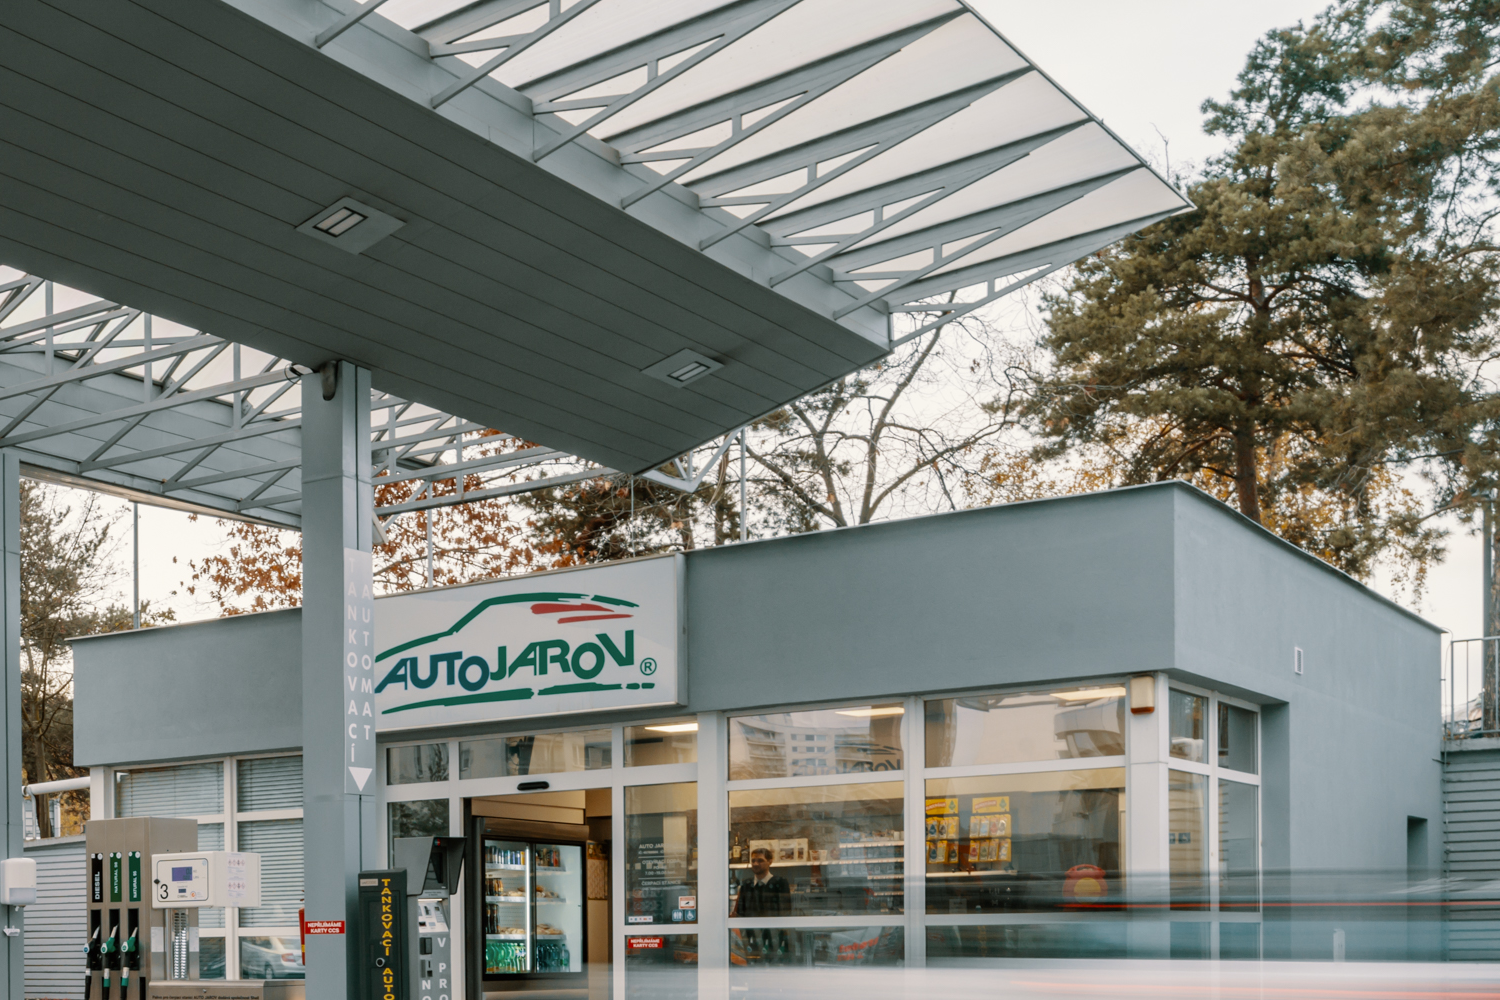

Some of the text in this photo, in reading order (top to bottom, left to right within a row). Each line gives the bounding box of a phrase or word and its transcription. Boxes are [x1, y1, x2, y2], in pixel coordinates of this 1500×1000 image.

[160, 884, 169, 900] 3
[381, 878, 393, 956] TANKOVACÍ
[437, 937, 447, 948] V
